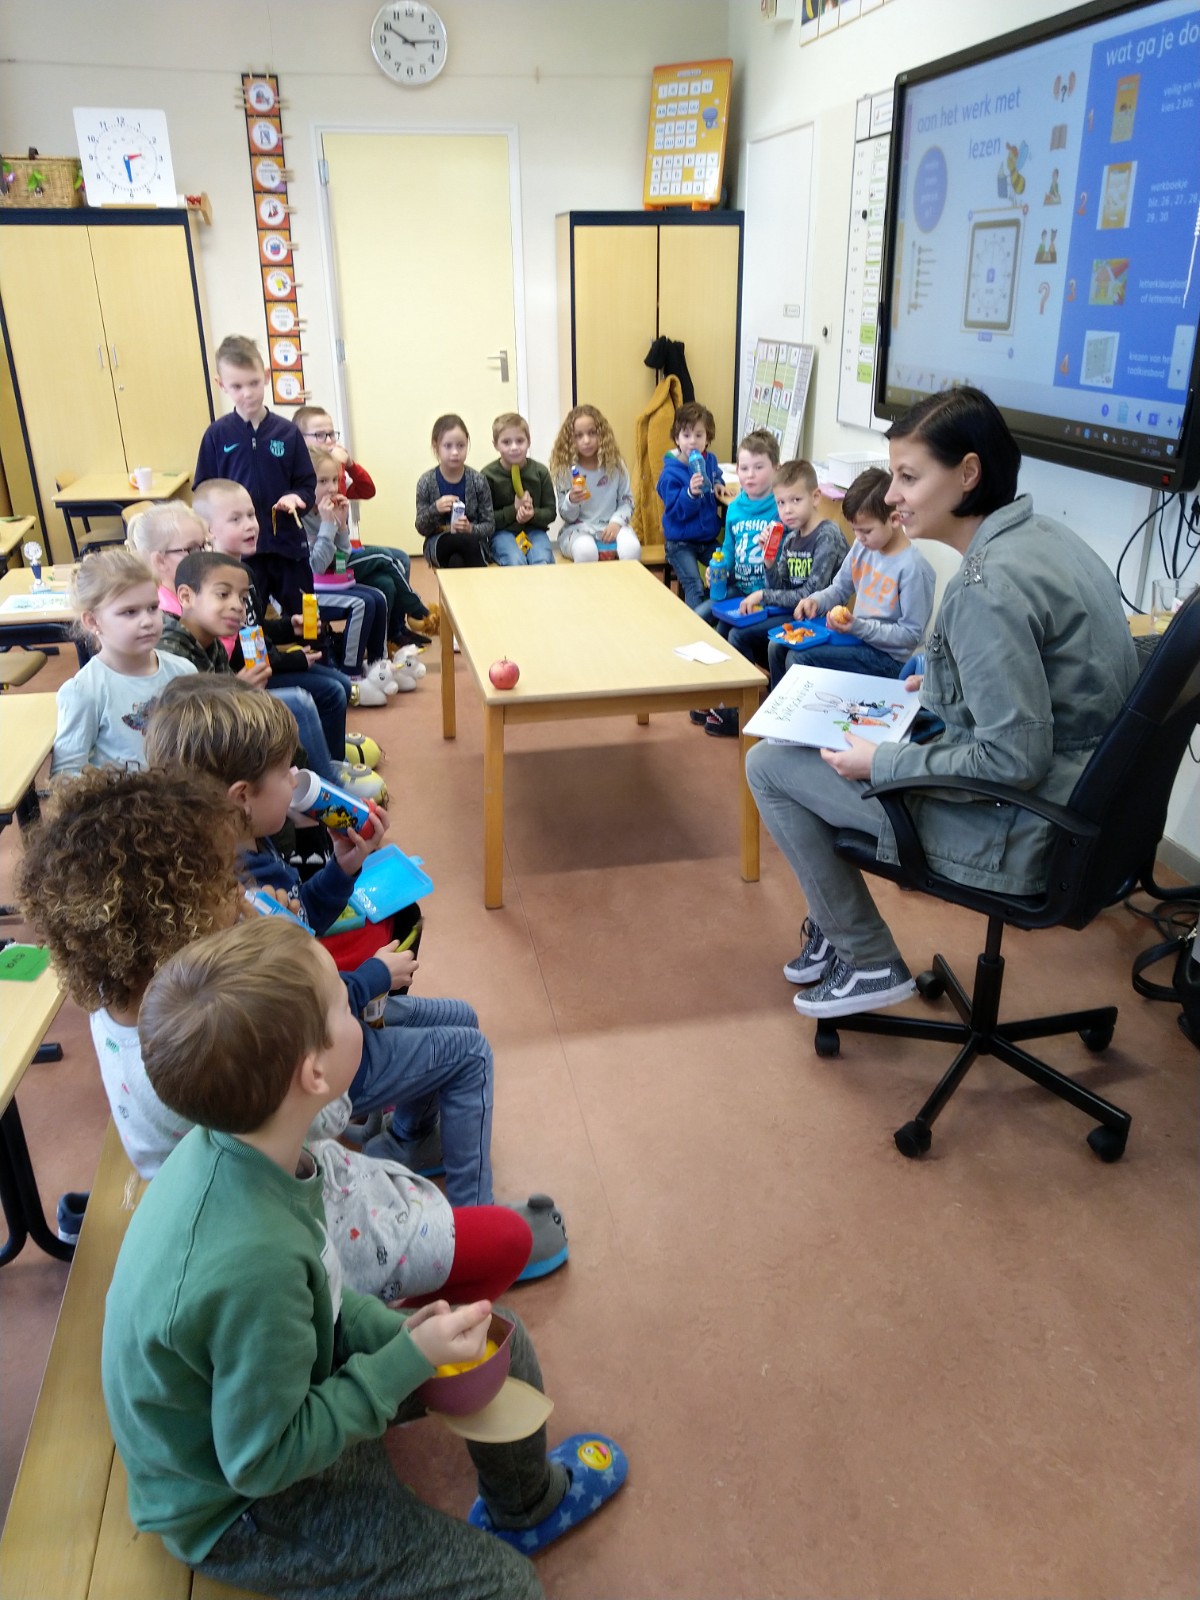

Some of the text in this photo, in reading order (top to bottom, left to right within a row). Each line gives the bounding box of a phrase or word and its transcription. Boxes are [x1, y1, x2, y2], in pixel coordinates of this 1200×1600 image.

[394, 10, 400, 20] 11
[428, 24, 435, 34] 2
[380, 34, 386, 45] 9
[1106, 20, 1200, 67] wat ga je do
[428, 53, 434, 64] 4
[395, 62, 401, 72] 7
[406, 67, 413, 77] 6
[420, 64, 426, 74] 5
[918, 86, 1021, 134] aan het werk met
[969, 138, 1000, 160] lezen
[1077, 191, 1088, 216] 2
[1067, 278, 1076, 302] 3
[1059, 353, 1070, 377] 4
